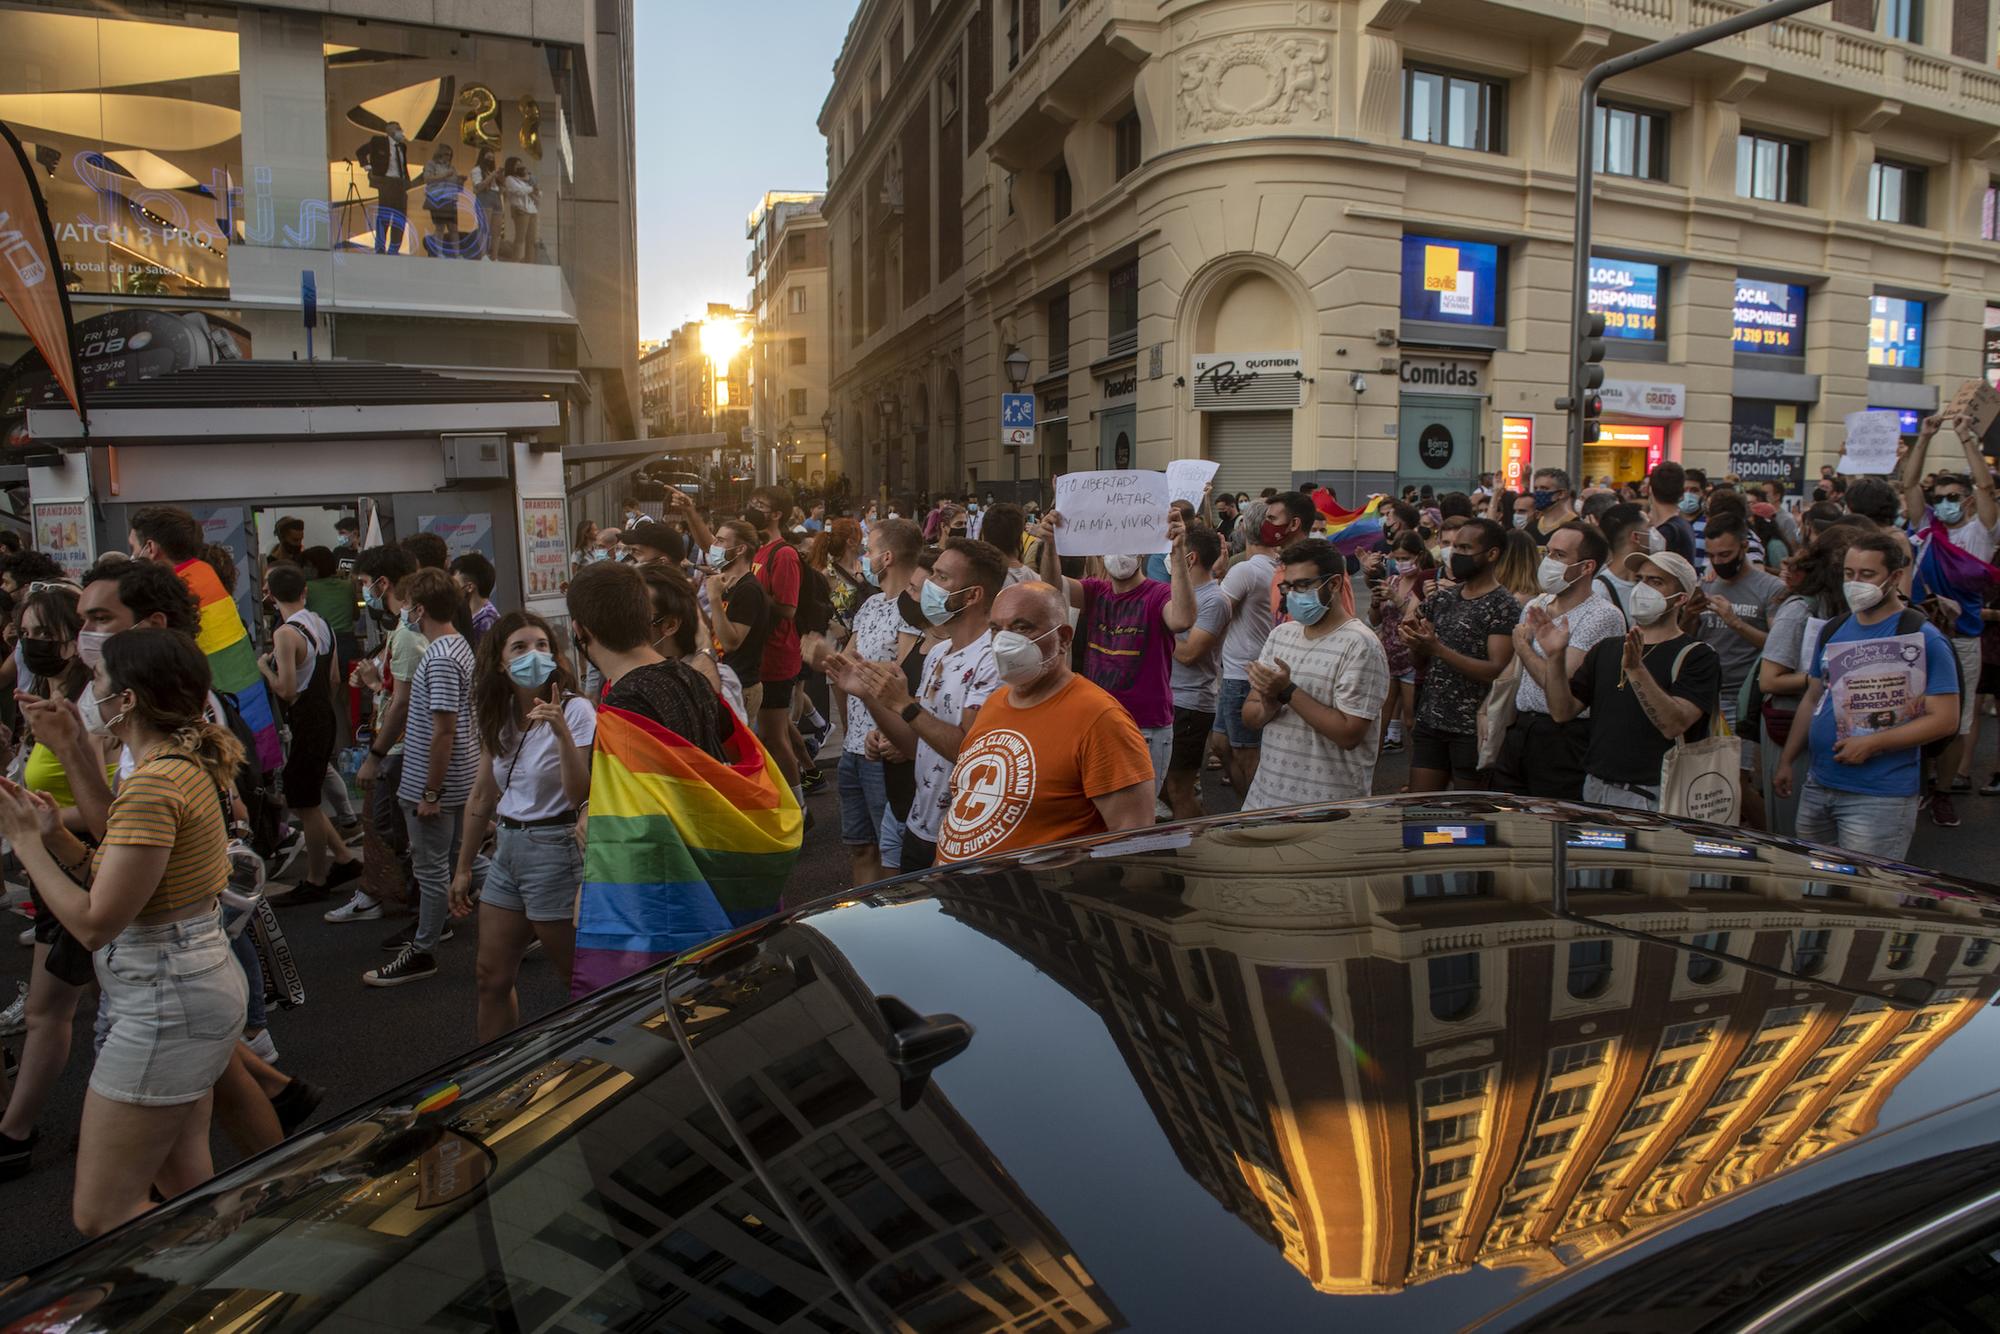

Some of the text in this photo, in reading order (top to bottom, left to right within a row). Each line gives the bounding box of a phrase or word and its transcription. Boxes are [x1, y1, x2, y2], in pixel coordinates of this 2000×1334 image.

[139, 227, 152, 246] 3
[162, 229, 213, 249] PRO
[75, 261, 105, 273] total
[109, 263, 125, 274] de
[129, 263, 142, 274] tu
[1426, 275, 1457, 290] savills
[1589, 267, 1634, 286] LOCAL
[1604, 311, 1625, 327] 319
[1627, 313, 1640, 328] 13
[83, 328, 119, 343] FRI 18
[1743, 327, 1762, 343] 319
[1764, 329, 1776, 344] 13
[1777, 331, 1790, 346] 14
[1196, 358, 1299, 370] LE QUOTIDIEN
[1400, 360, 1478, 387] Comidas
[1645, 393, 1677, 406] GRATIS
[1728, 439, 1760, 456] ocal
[1081, 475, 1138, 490] LIBERTAD?
[525, 501, 560, 509] GRANIZADOS
[1106, 492, 1156, 506] MATAR
[536, 540, 550, 548] AGUA
[537, 553, 561, 563] HELADOS
[1851, 688, 1905, 702] ¡BASTA DE
[986, 733, 1026, 756] CLOTHING
[1015, 752, 1030, 795] BRAND
[944, 839, 962, 855] AND
[962, 820, 1006, 855] SUPPLY
[1002, 804, 1024, 824] CO.
